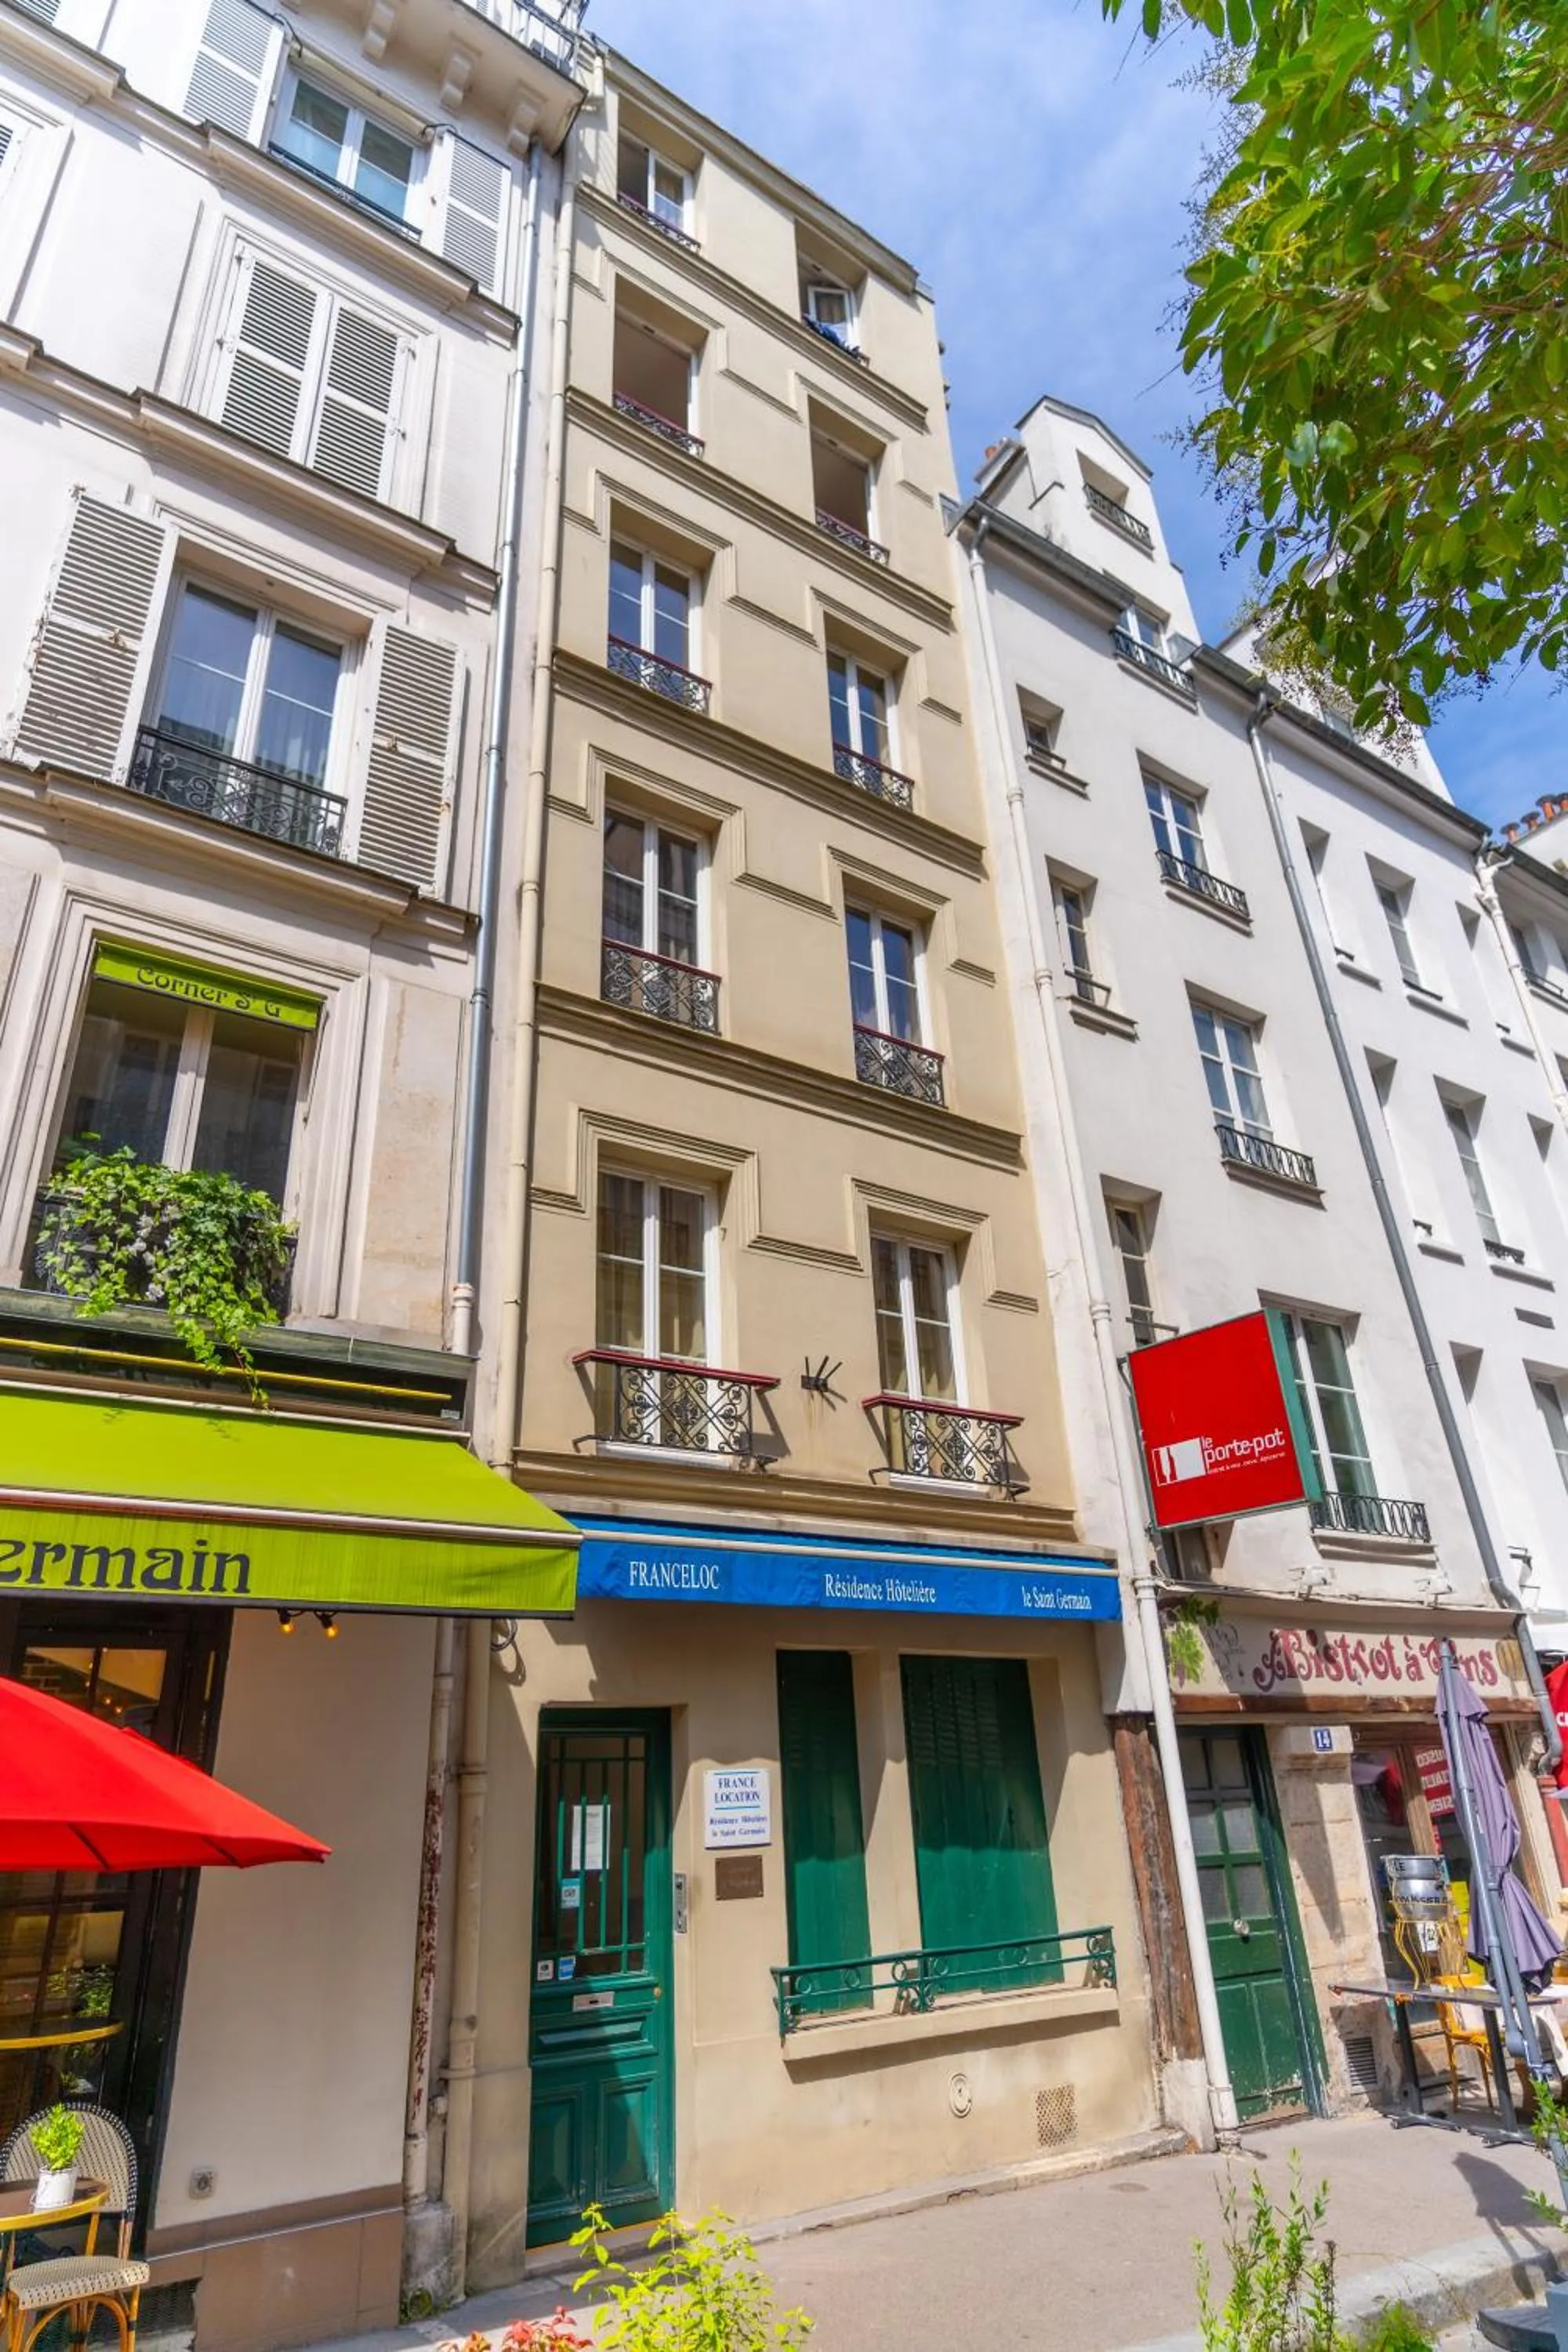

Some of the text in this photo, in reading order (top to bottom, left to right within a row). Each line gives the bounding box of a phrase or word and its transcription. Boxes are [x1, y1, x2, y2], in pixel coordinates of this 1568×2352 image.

[137, 965, 228, 1004] Corner
[1201, 1436, 1214, 1449] le
[1203, 1428, 1286, 1470] porte-pot
[629, 1561, 720, 1590] FRANCELOC
[824, 1573, 937, 1604] Résidence Hôtelière
[1022, 1584, 1032, 1608] le
[1252, 1628, 1402, 1693] Bistrot
[1403, 1635, 1425, 1682] à
[1316, 1730, 1330, 1748] 14
[717, 1776, 757, 1789] FRANCE
[714, 1791, 760, 1804] LOCATION
